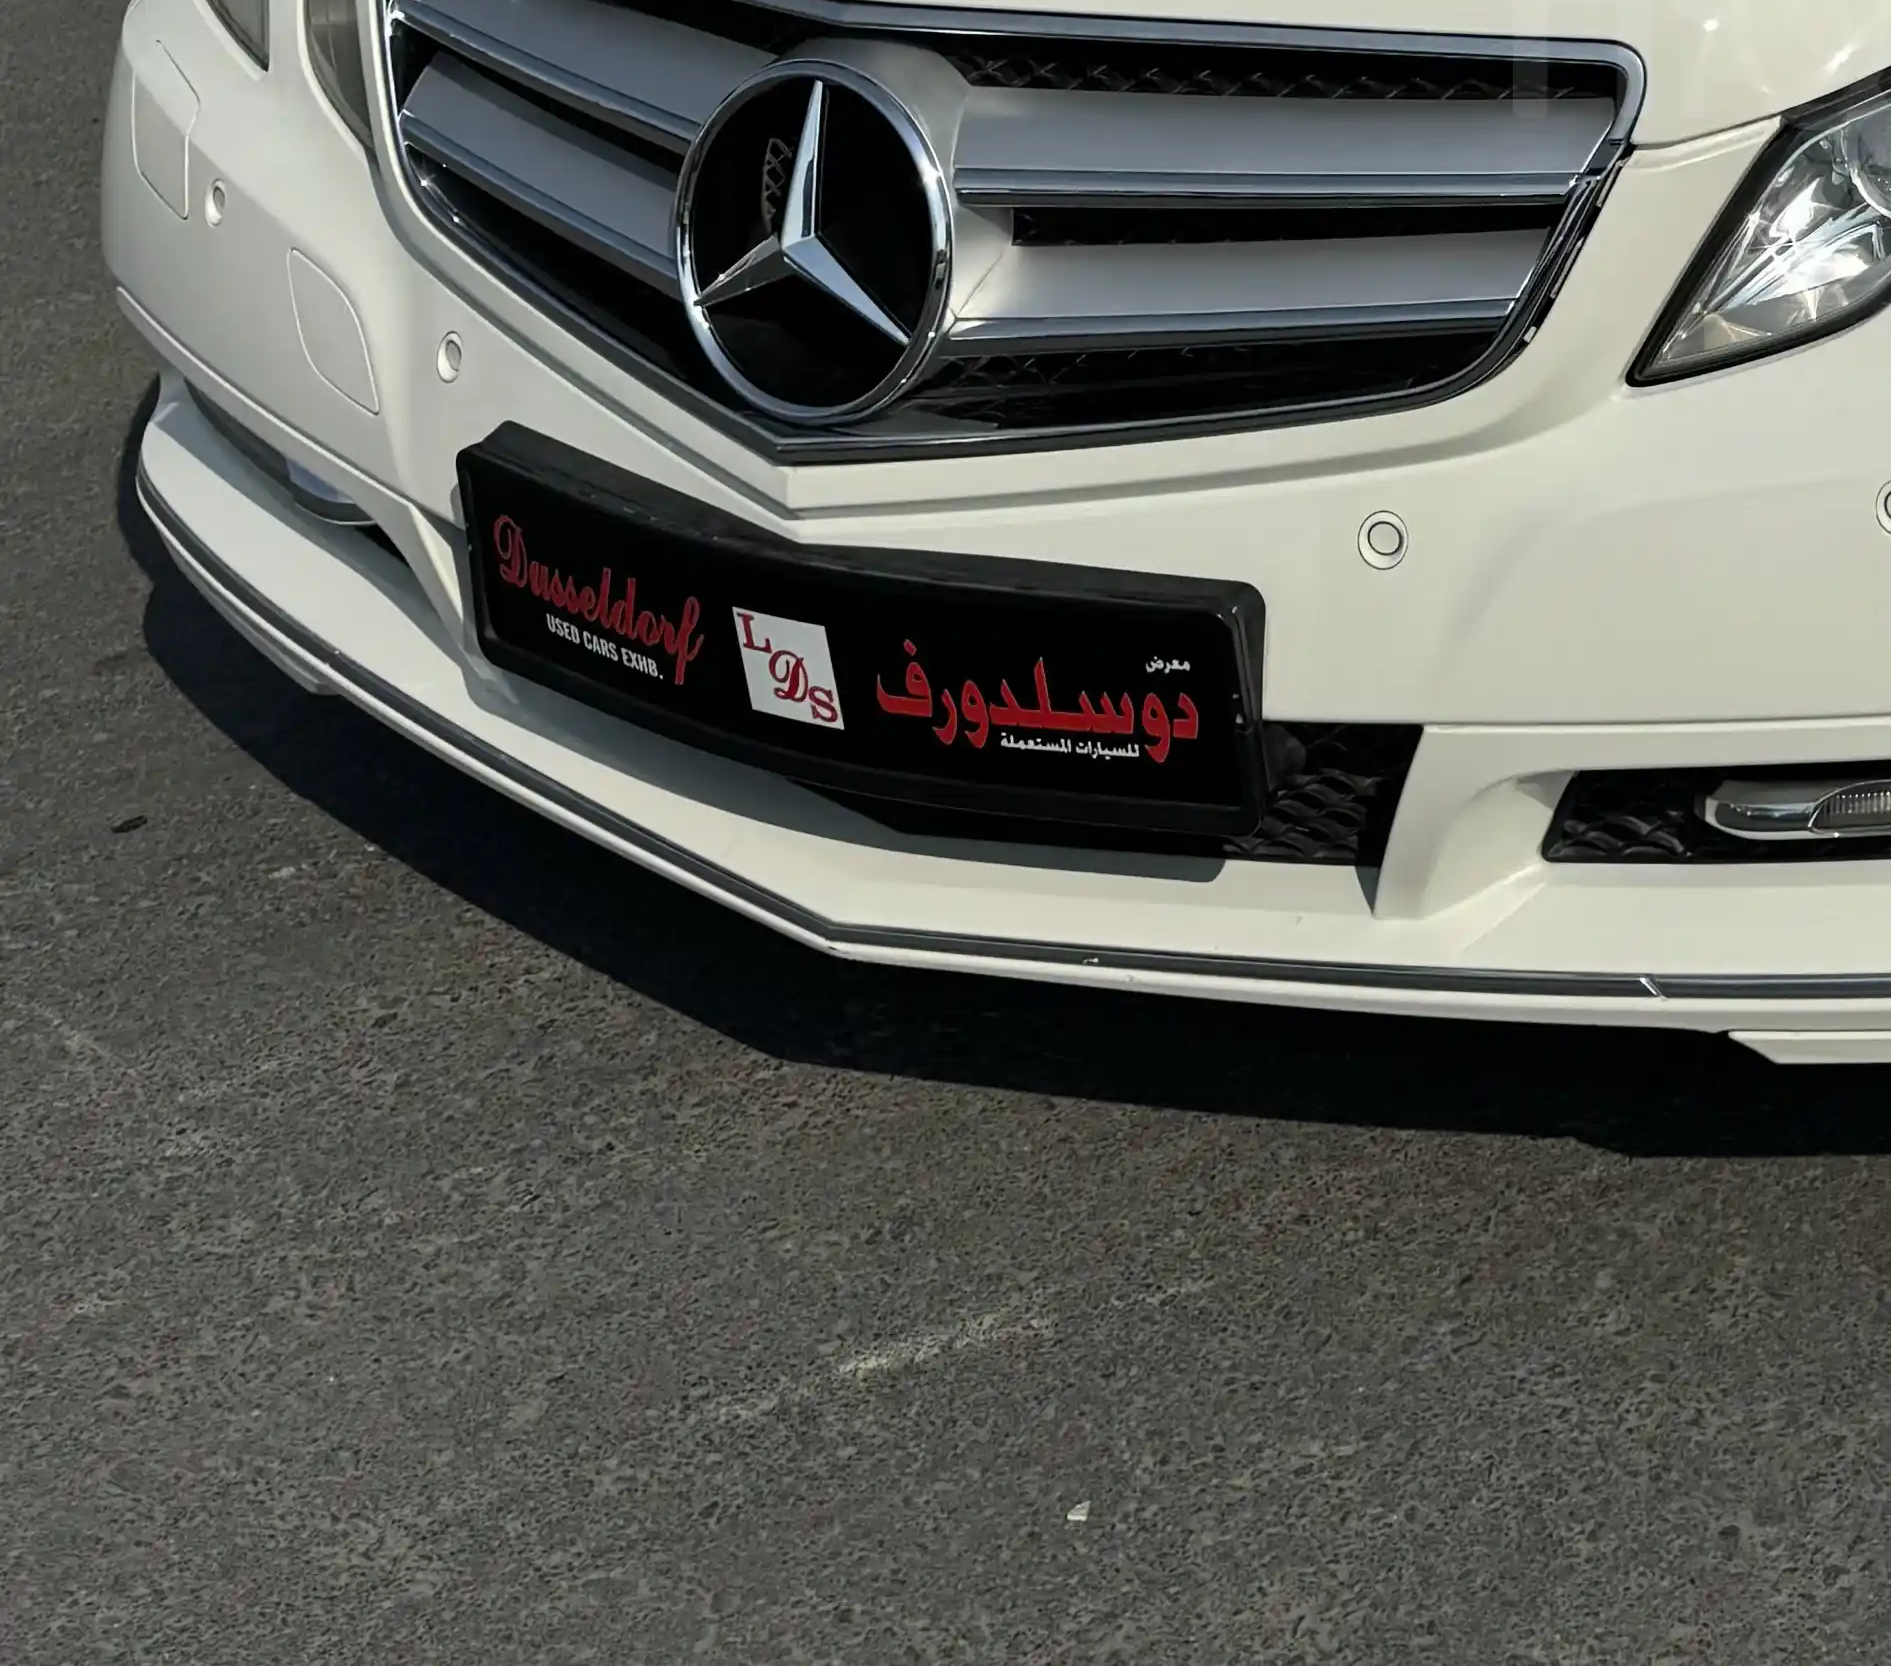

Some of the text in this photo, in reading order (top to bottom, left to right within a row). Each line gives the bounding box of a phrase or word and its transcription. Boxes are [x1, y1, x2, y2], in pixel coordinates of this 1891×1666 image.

[493, 514, 704, 685] Dusseldorf
[545, 612, 581, 645] USED
[582, 630, 619, 662] CARS
[1144, 655, 1191, 674] معرض
[876, 638, 1199, 764] دوسلدورف
[1000, 732, 1140, 761] للسيارات المستعملة
